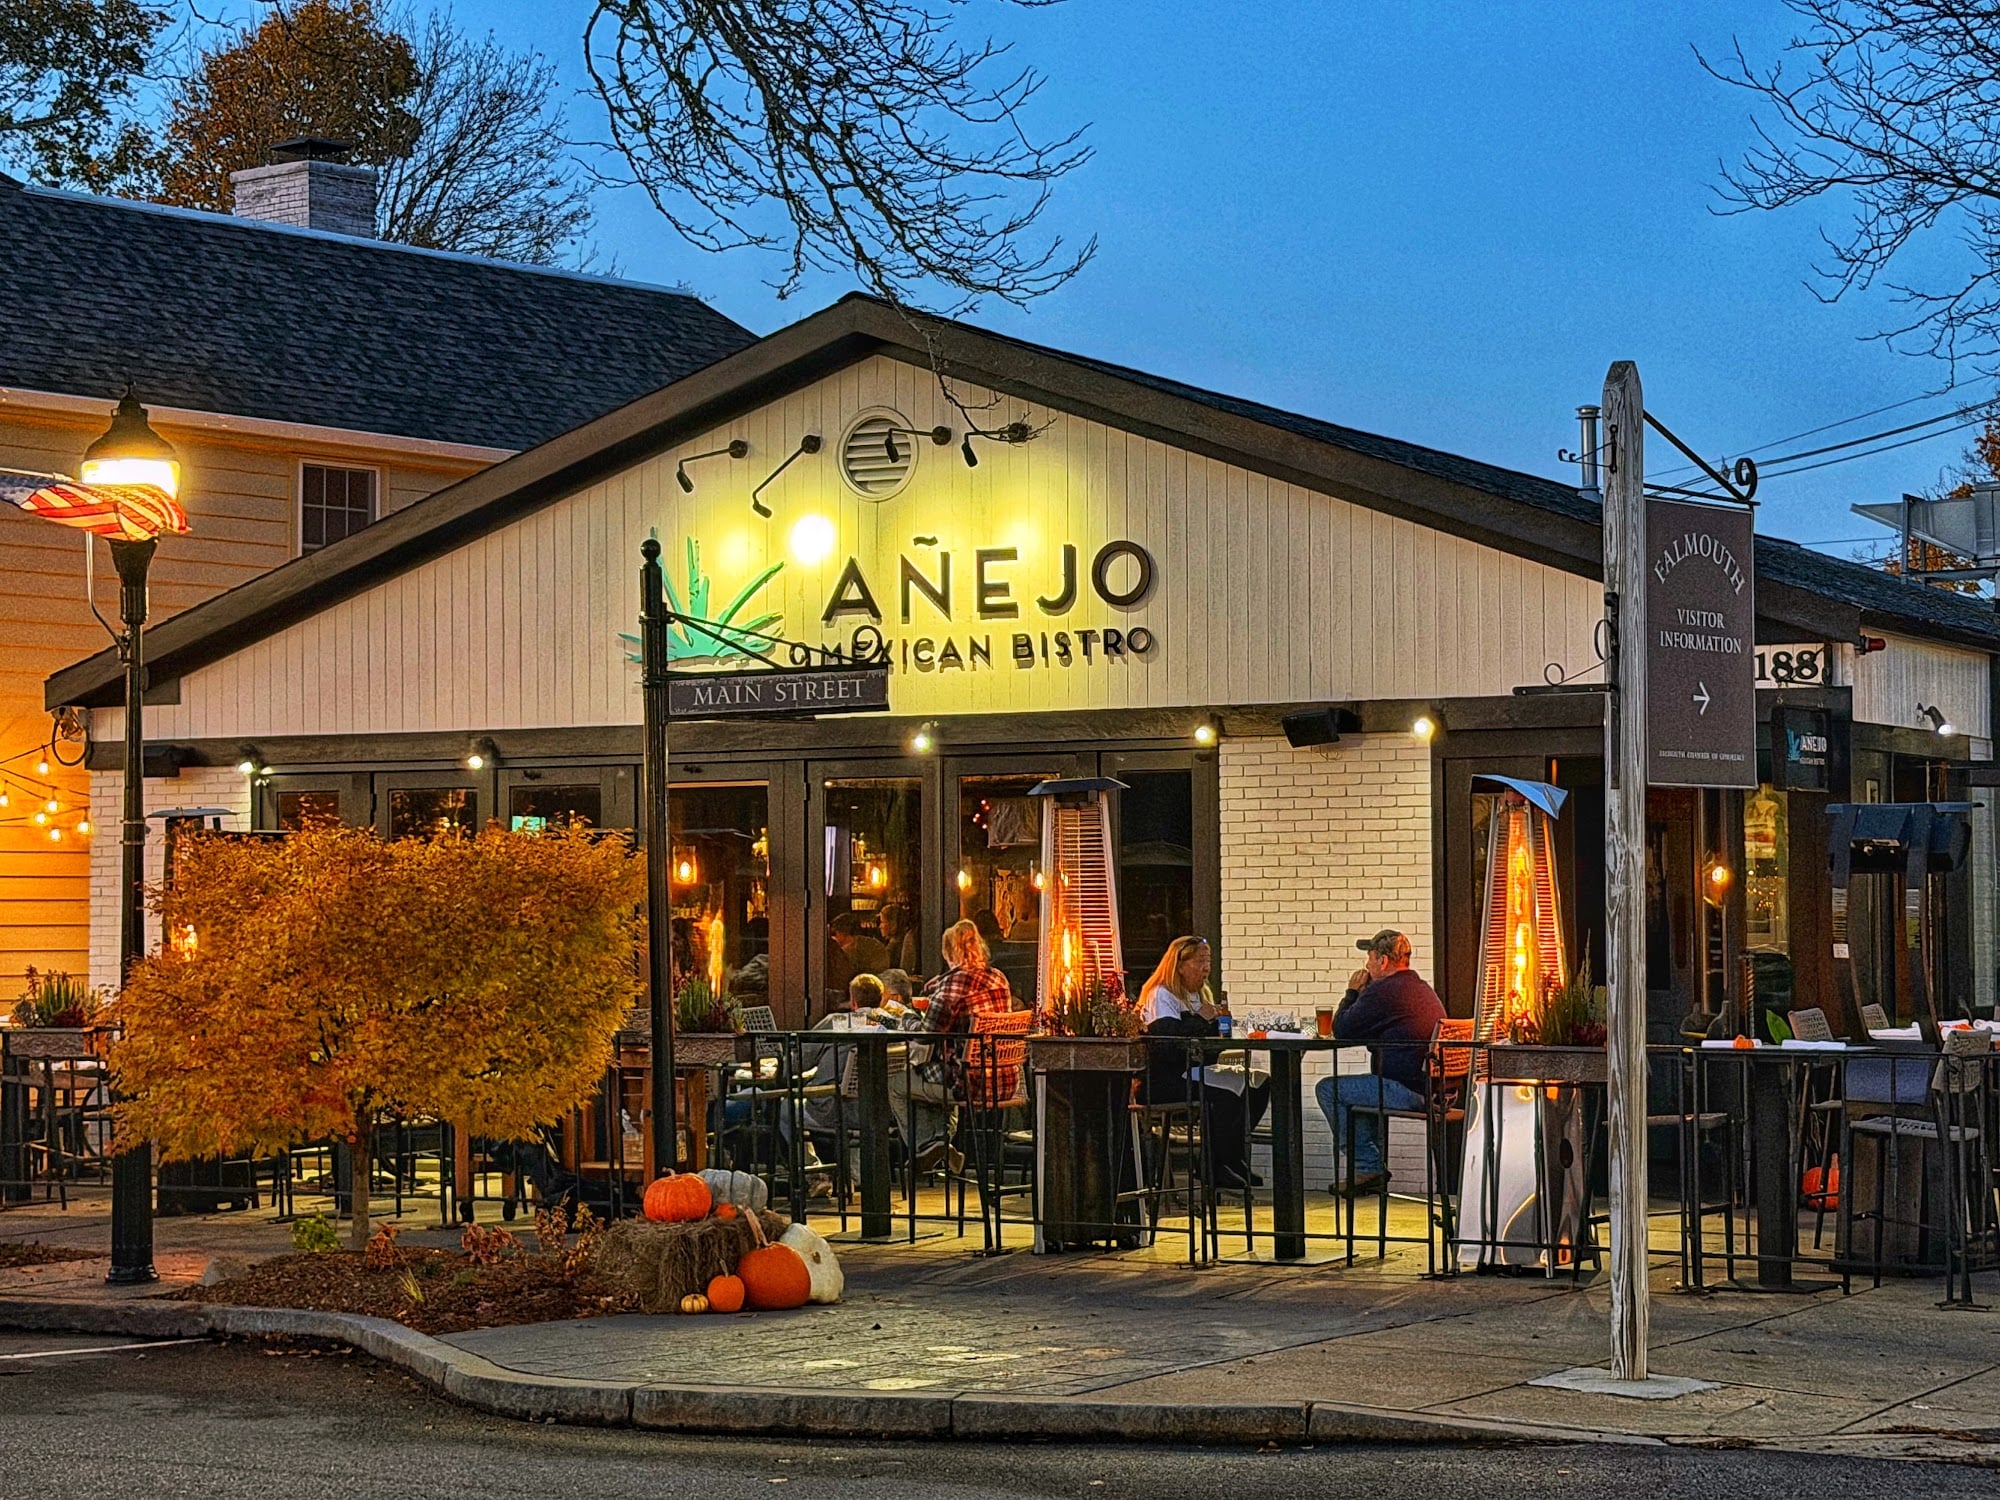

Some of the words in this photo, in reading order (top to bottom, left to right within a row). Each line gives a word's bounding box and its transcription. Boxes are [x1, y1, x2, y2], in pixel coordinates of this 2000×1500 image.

[821, 536, 1152, 622] AÑEJO
[1654, 532, 1746, 596] FALMOUTH
[1677, 608, 1725, 629] VISITOR
[1012, 627, 1152, 660] BISTRO
[1660, 630, 1742, 654] INFORMATION
[1754, 650, 1818, 681] 188
[693, 684, 761, 706] MAIN
[775, 678, 866, 702] STREET
